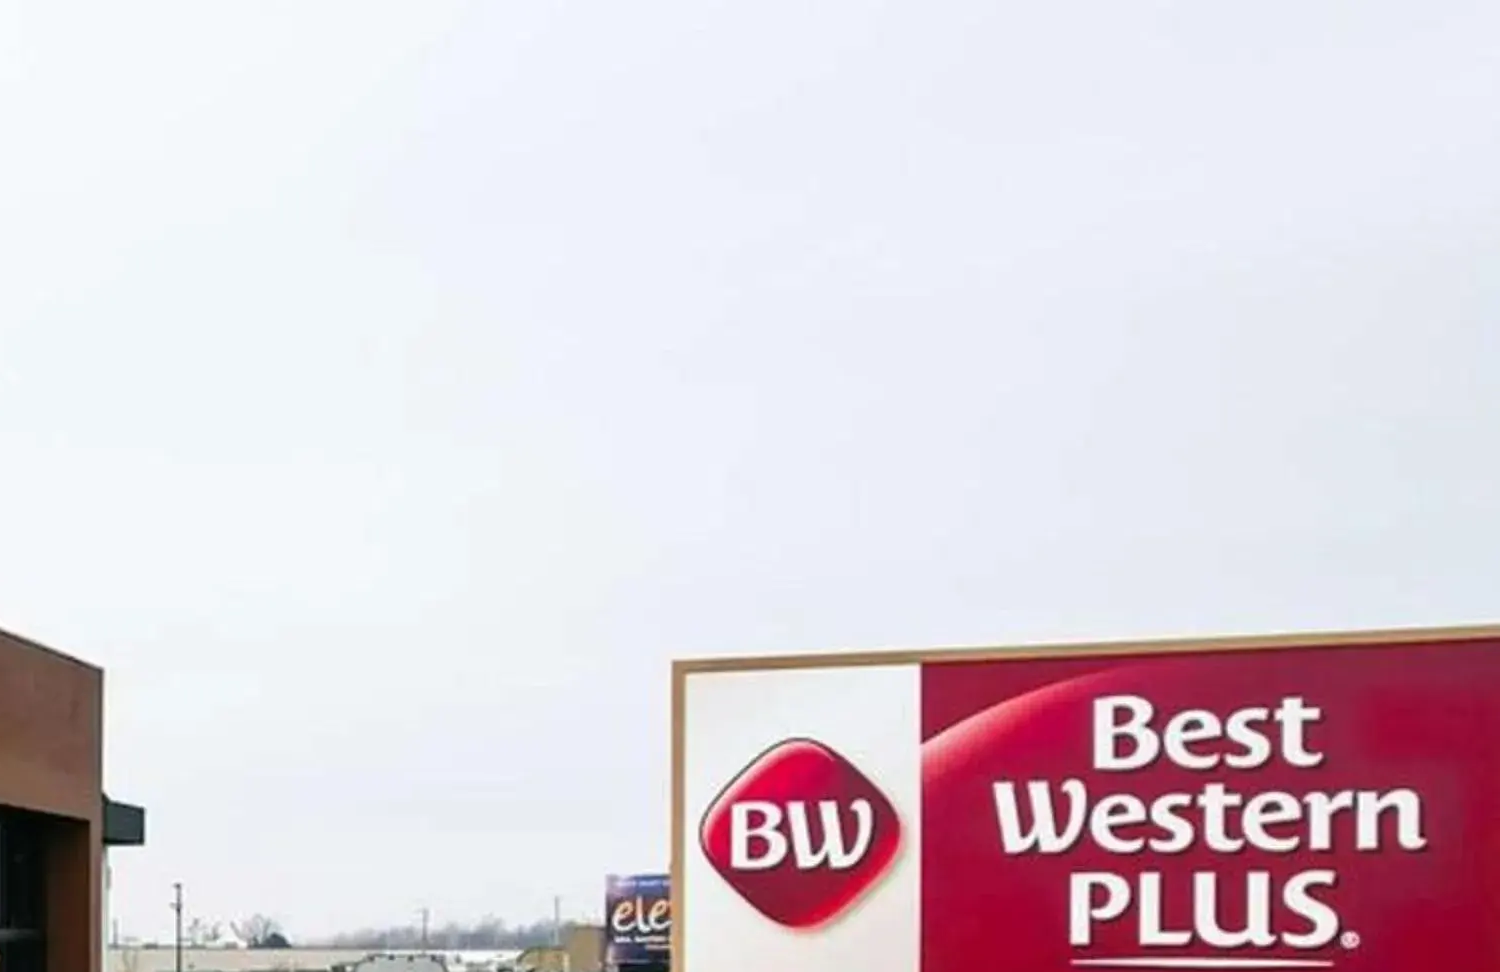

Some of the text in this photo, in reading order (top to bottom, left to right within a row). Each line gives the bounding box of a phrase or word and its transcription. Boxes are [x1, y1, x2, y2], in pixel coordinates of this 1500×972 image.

[1092, 694, 1325, 771] Best
[729, 798, 873, 870] BW
[992, 778, 1427, 854] Western
